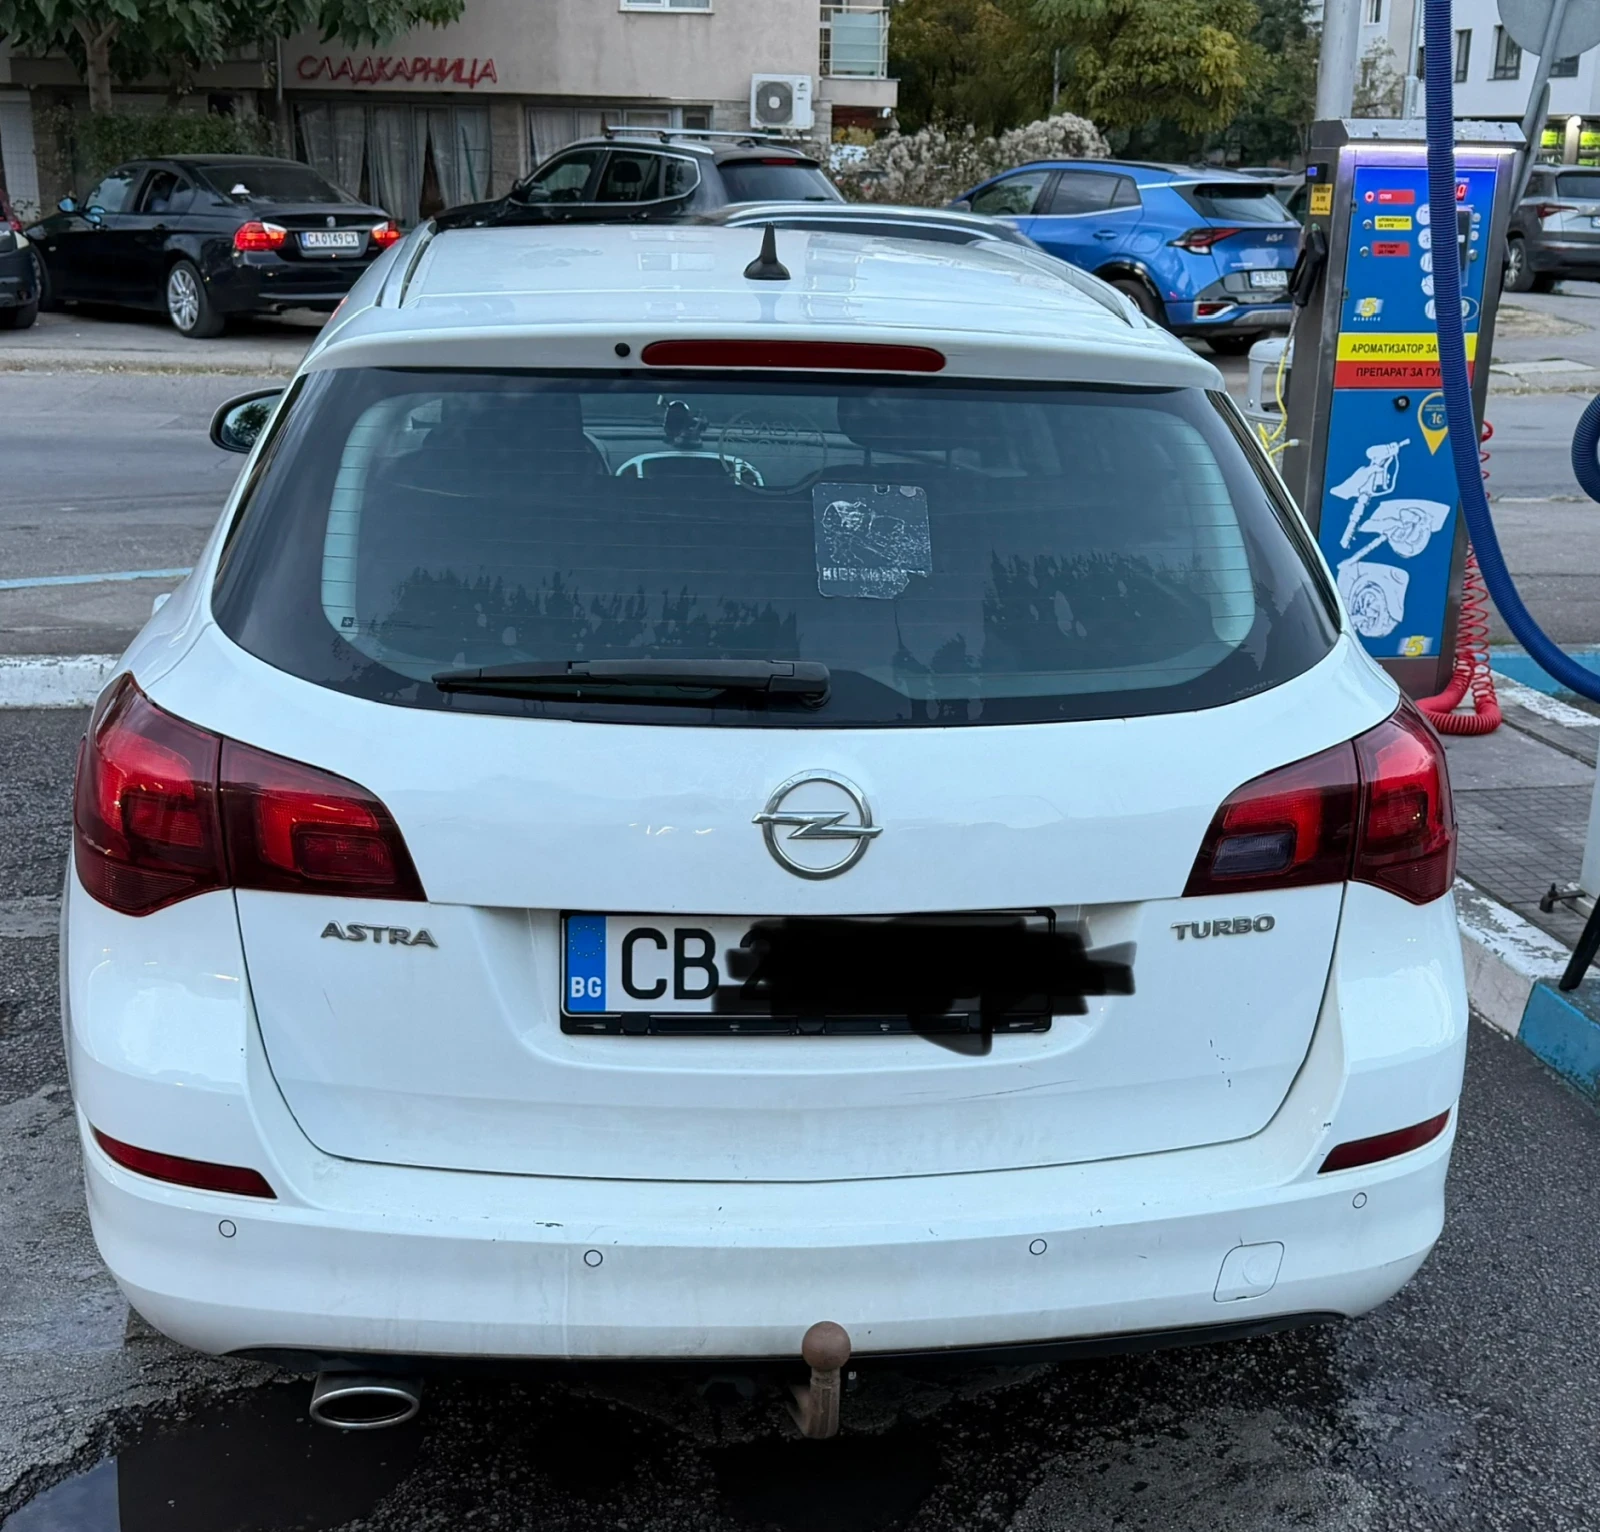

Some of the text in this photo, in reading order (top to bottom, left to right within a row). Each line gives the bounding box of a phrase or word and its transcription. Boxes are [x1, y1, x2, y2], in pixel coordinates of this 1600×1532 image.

[297, 55, 498, 89] СЛАДКАРНИЦА
[1351, 343, 1438, 354] АРОМАТИЗАТОР ЗА
[1356, 367, 1408, 377] ПРЕПАРАТ
[1410, 367, 1423, 377] ЗА
[320, 920, 439, 948] ASTRA
[1170, 914, 1276, 941] TURBO
[570, 976, 602, 998] BG
